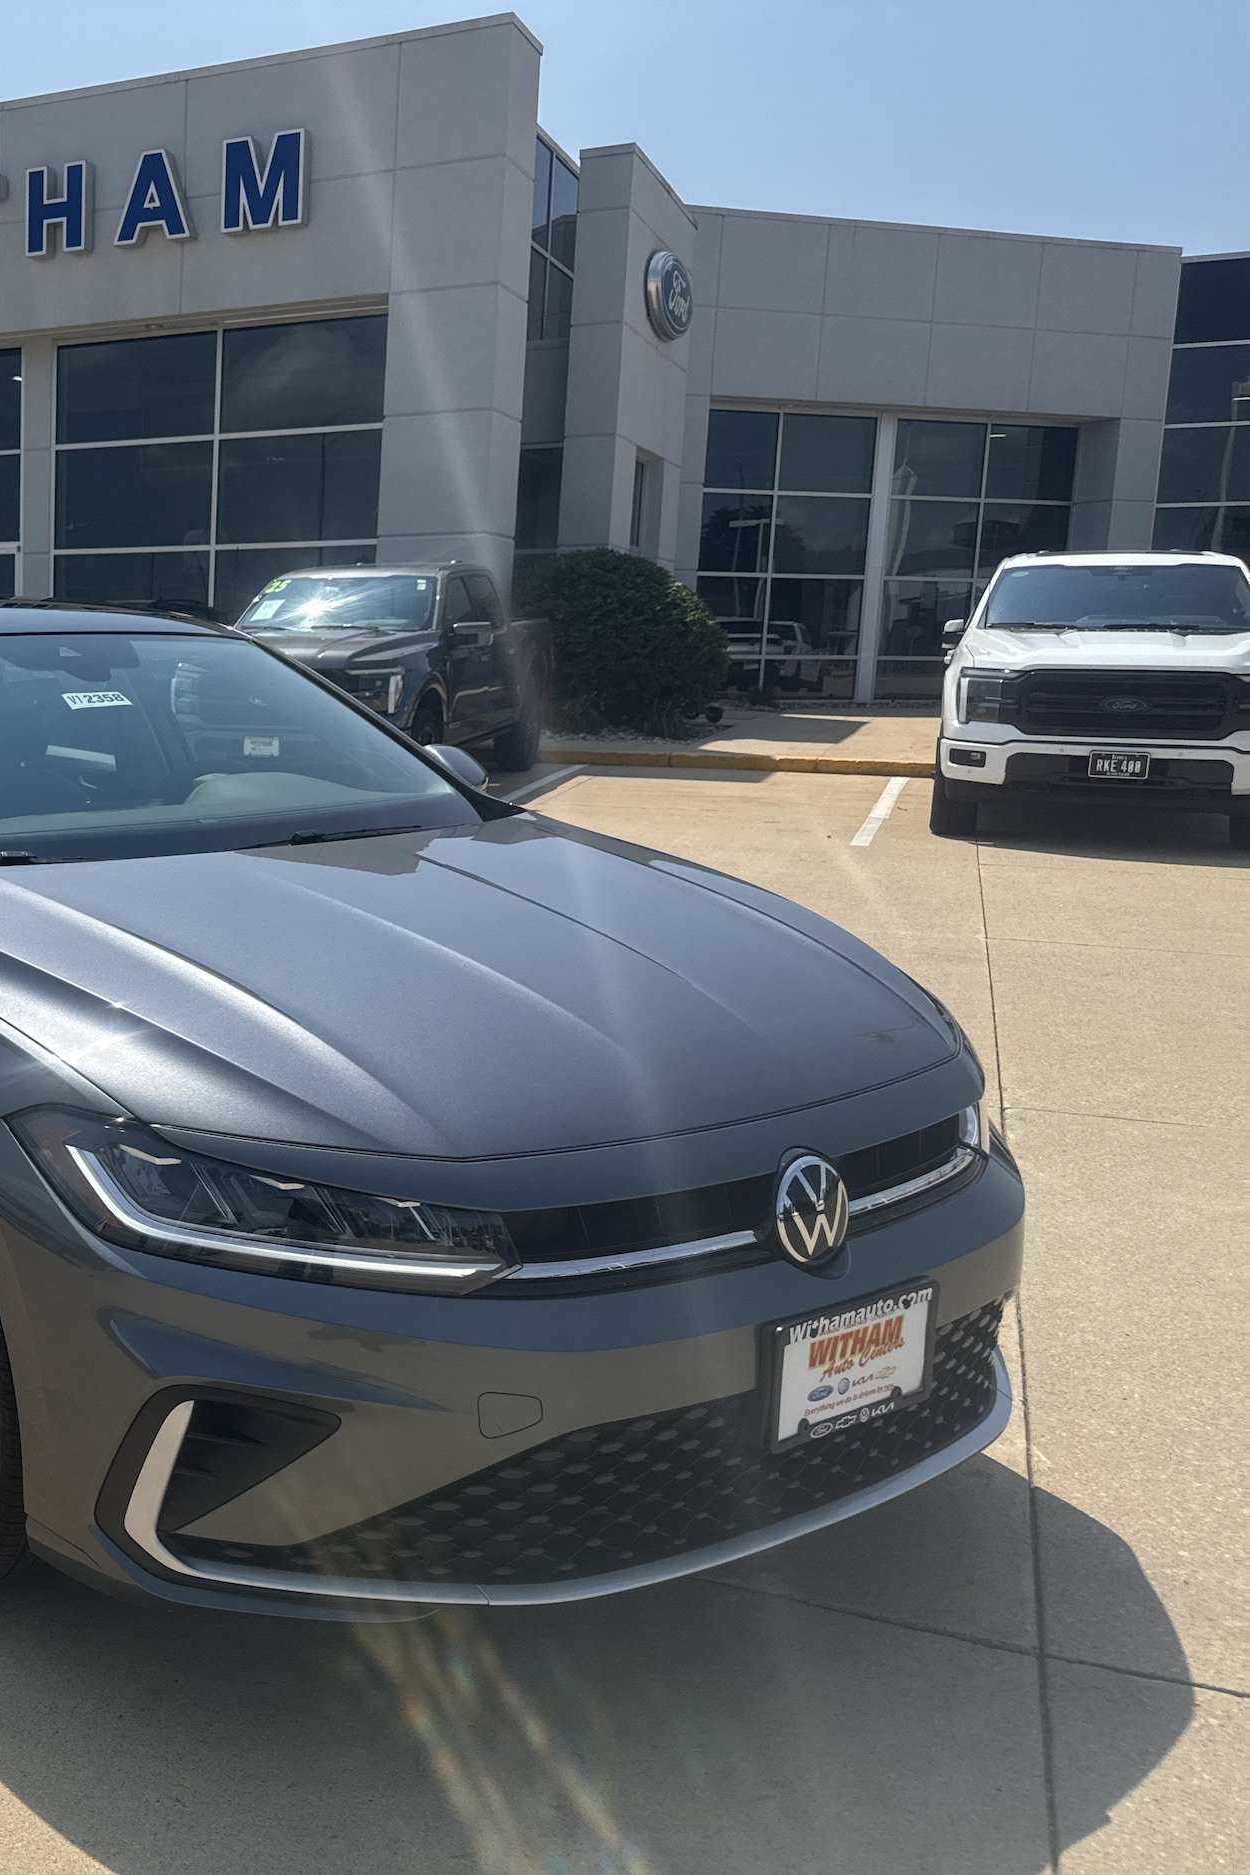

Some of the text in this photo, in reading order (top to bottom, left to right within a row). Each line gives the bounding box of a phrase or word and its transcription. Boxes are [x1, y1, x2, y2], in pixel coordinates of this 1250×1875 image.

[667, 269, 690, 323] Ford
[808, 1314, 904, 1369] WITHAM
[820, 1357, 855, 1383] Auto
